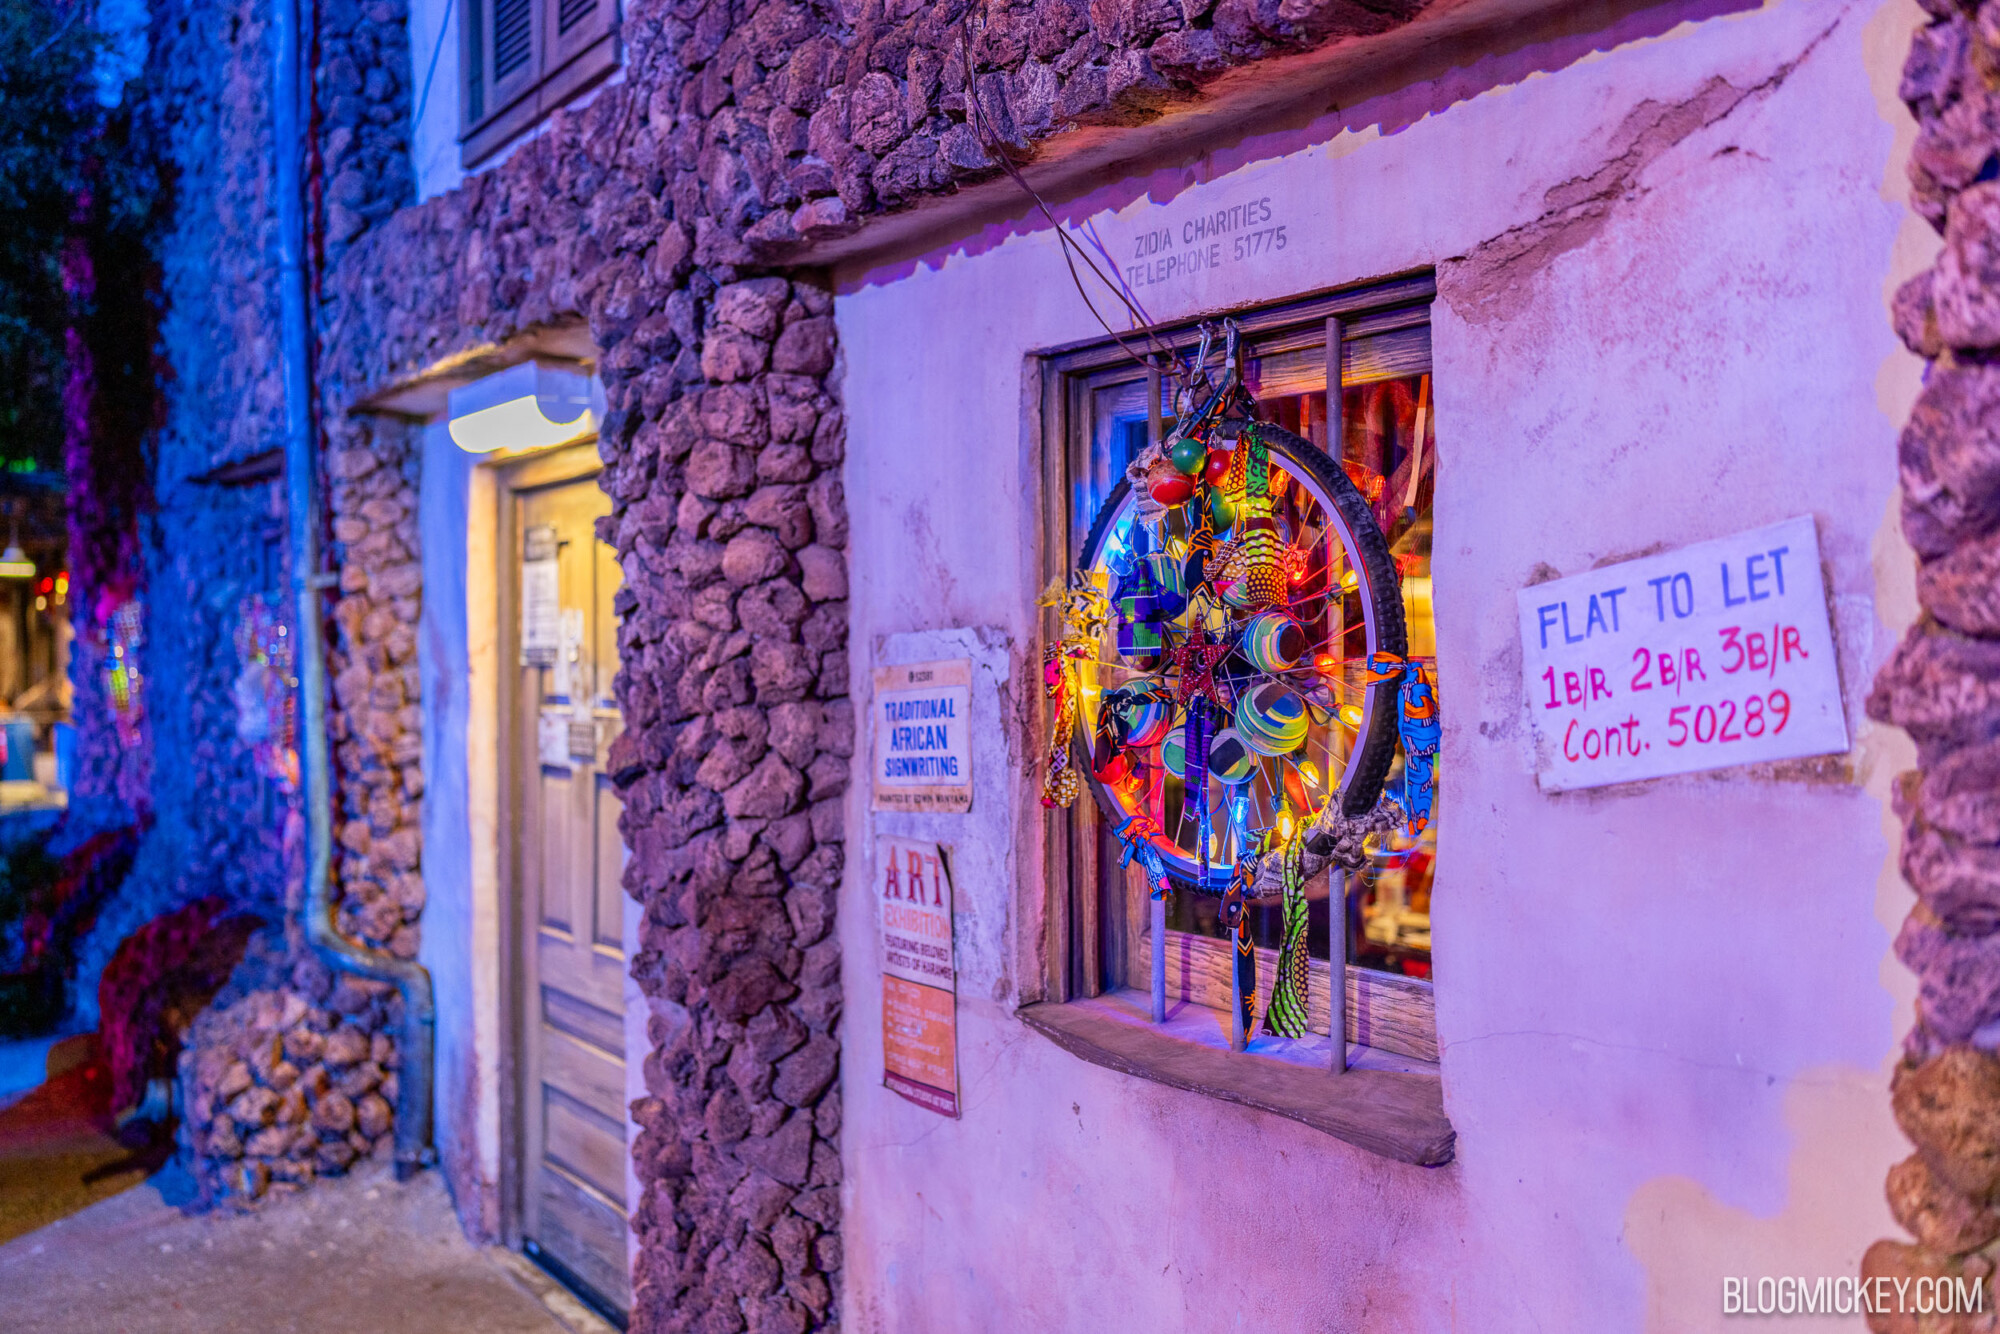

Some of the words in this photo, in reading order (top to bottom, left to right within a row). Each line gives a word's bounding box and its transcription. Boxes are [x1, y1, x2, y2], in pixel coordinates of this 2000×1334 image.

[1126, 243, 1220, 289] TELEPHONE
[1234, 225, 1287, 261] 51775
[1135, 228, 1172, 259] ZIDIA
[1183, 197, 1272, 245] CHARITIES
[1537, 586, 1627, 649] FLAT
[1648, 572, 1694, 622] TO
[1721, 546, 1789, 608] LET
[1542, 664, 1613, 711] 1B/R
[1631, 646, 1707, 697] 2B/R
[1718, 623, 1809, 680] 3B/R
[885, 698, 955, 722] TRADITIONAL
[891, 725, 948, 751] AFRICAN
[1563, 713, 1650, 762] Cont.
[1668, 689, 1791, 747] 50289
[885, 756, 958, 777] SIGNWRITING
[884, 845, 943, 907] ART
[884, 904, 950, 939] EXHIBITION
[885, 933, 919, 954] FEATURING
